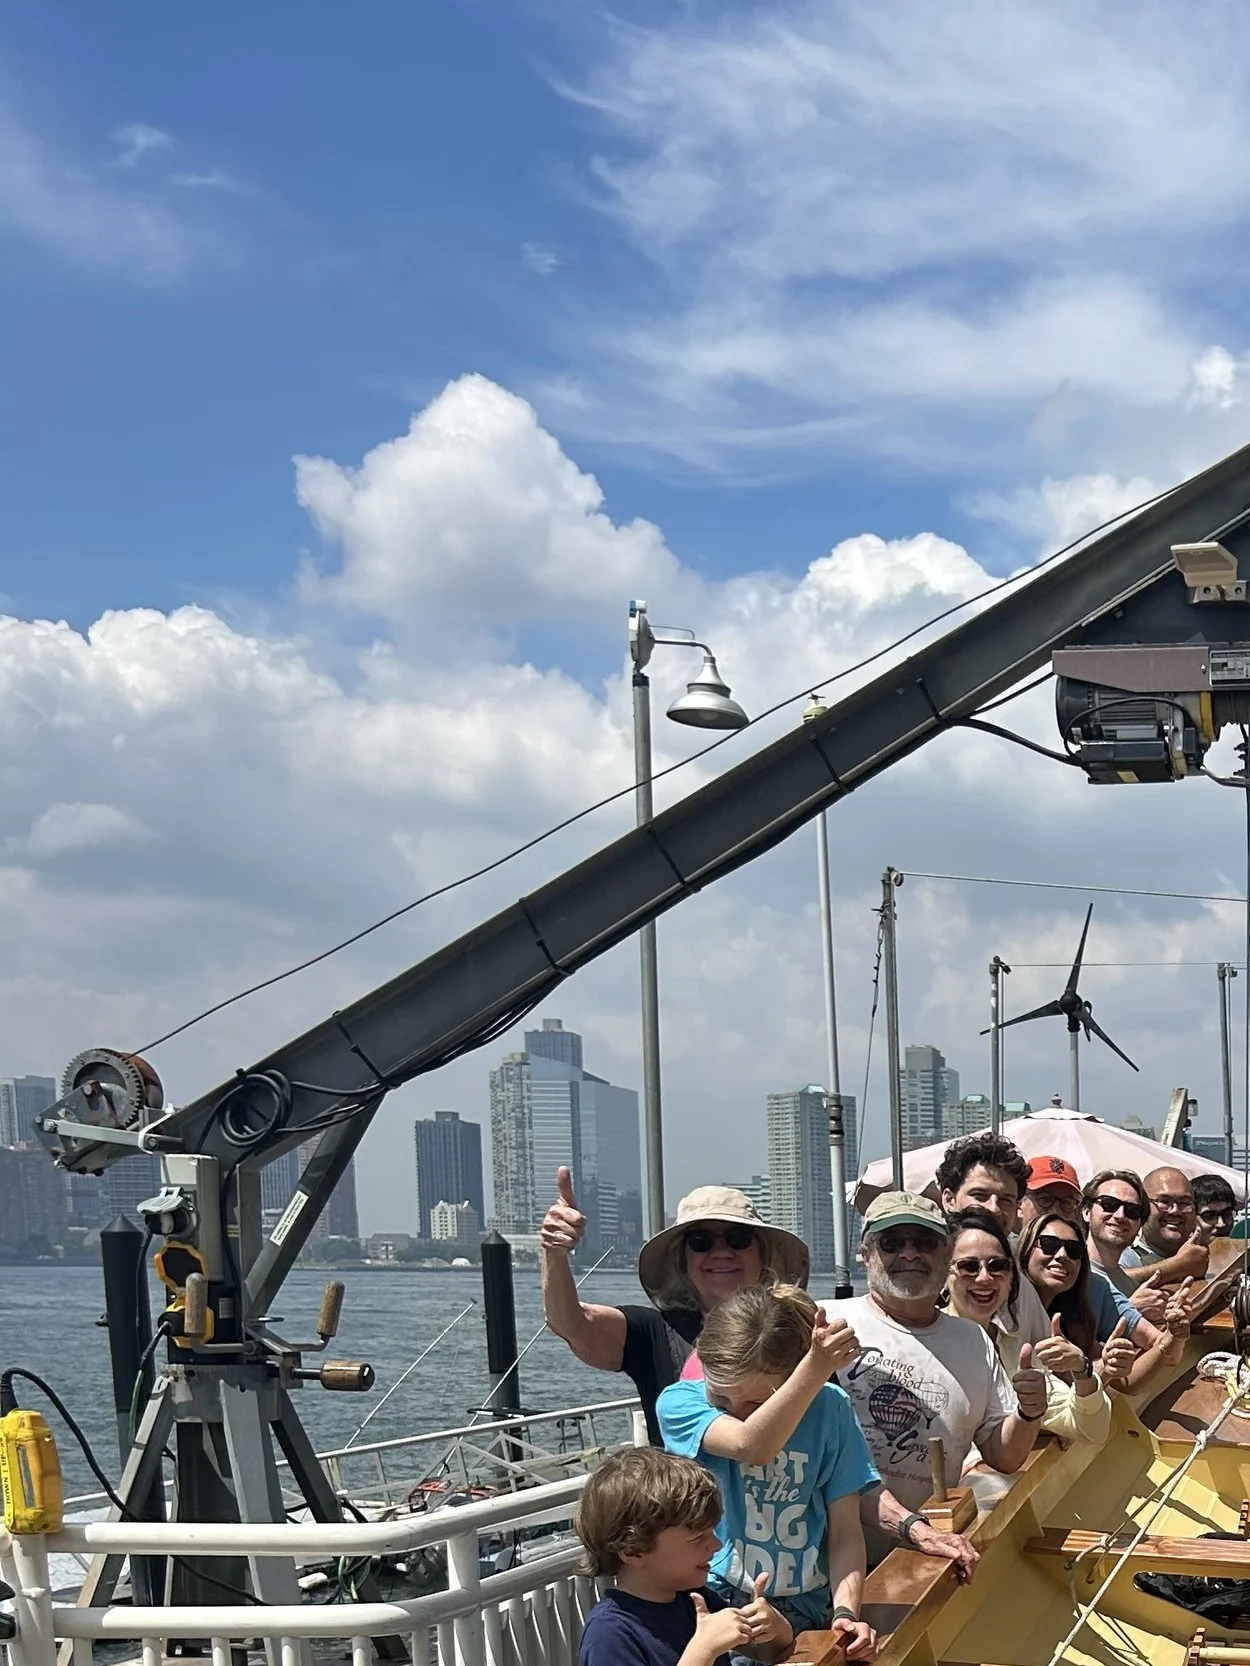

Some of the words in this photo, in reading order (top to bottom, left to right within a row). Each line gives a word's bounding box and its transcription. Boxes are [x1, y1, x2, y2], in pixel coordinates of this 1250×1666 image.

[888, 1369, 924, 1390] blood
[739, 1449, 809, 1484] ART
[764, 1475, 800, 1502] the
[726, 1538, 829, 1598] IDEA
